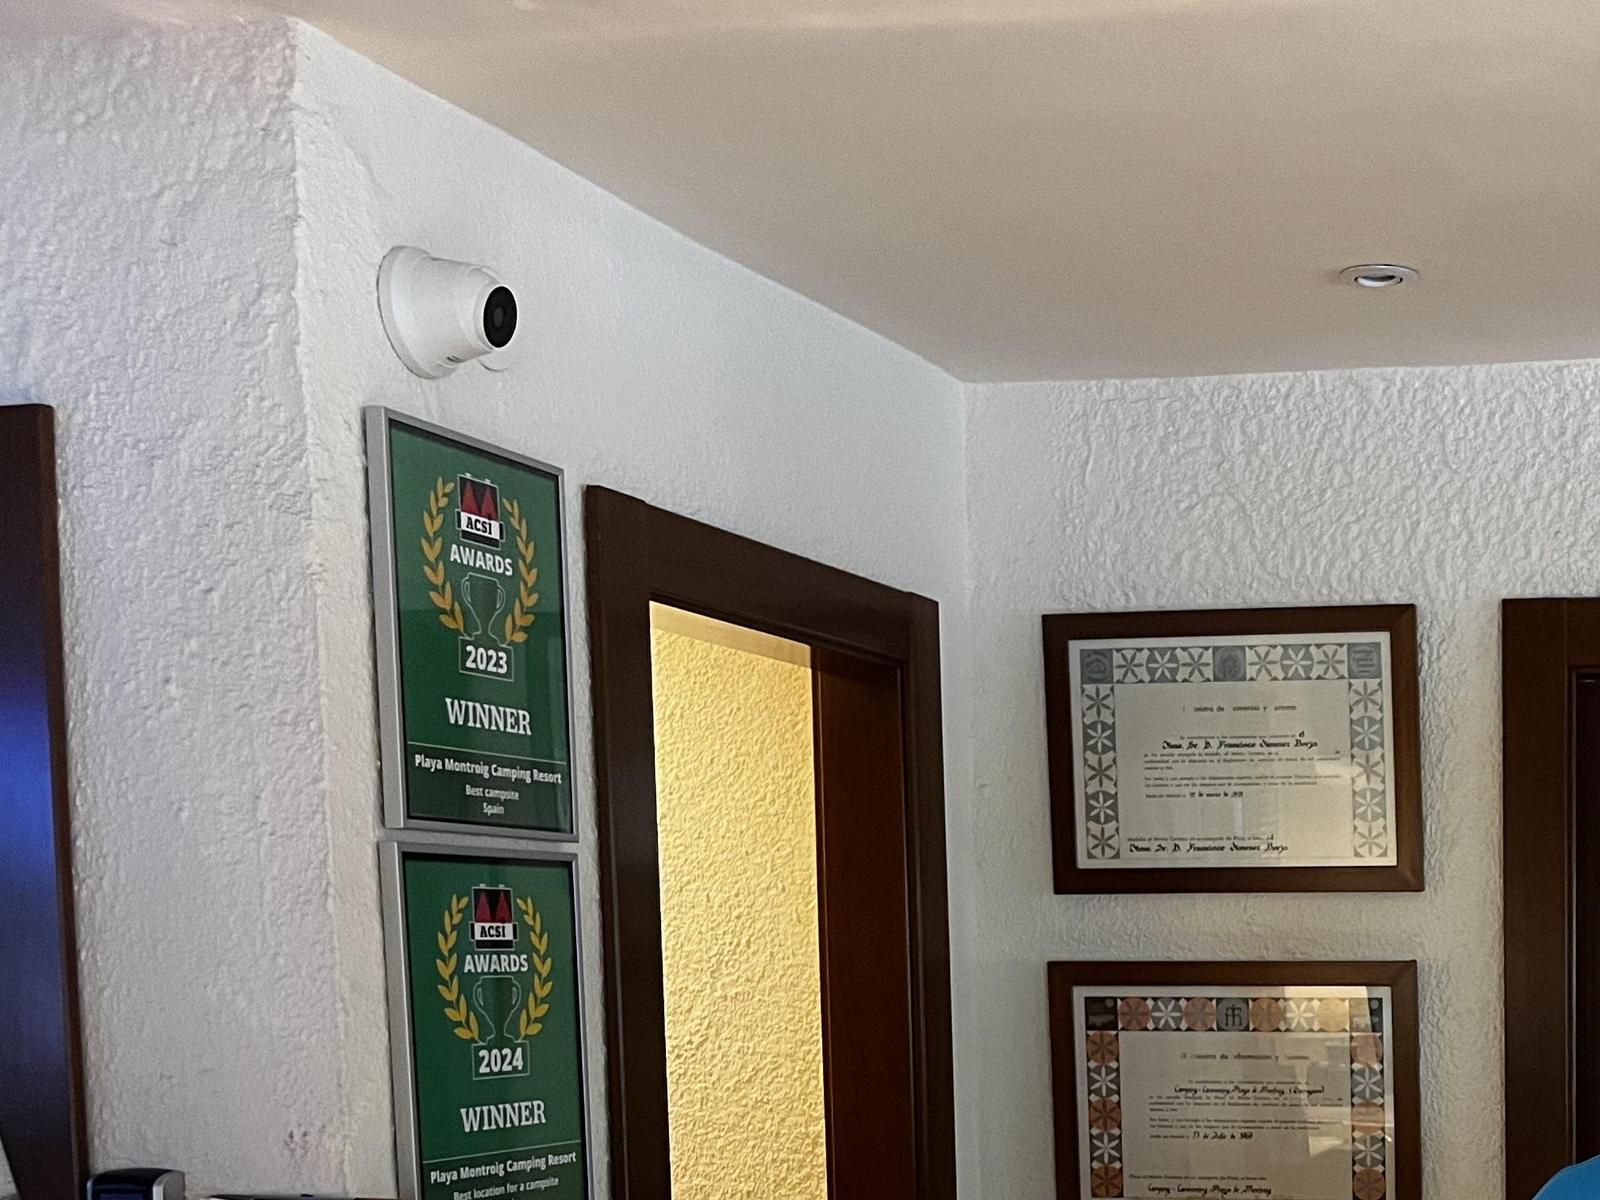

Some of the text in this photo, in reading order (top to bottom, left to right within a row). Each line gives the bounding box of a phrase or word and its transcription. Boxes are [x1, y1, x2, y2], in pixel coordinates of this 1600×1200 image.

[466, 516, 493, 536] ACSI
[450, 543, 513, 577] AWARDS
[465, 645, 508, 675] 2023
[444, 696, 532, 736] WINNER
[414, 754, 562, 784] Playa Montroig Camping Resort
[465, 784, 520, 802] Best campsite
[483, 802, 505, 816] Spain
[479, 925, 506, 938] ACSI
[464, 954, 529, 973] AWARDS
[479, 1047, 524, 1074] 2024
[460, 1100, 546, 1132] WINNER
[430, 1152, 577, 1186] Playa Montroig Camping Resort
[473, 1184, 505, 1200] location
[506, 1183, 518, 1194] for
[525, 1176, 559, 1191] campsite
